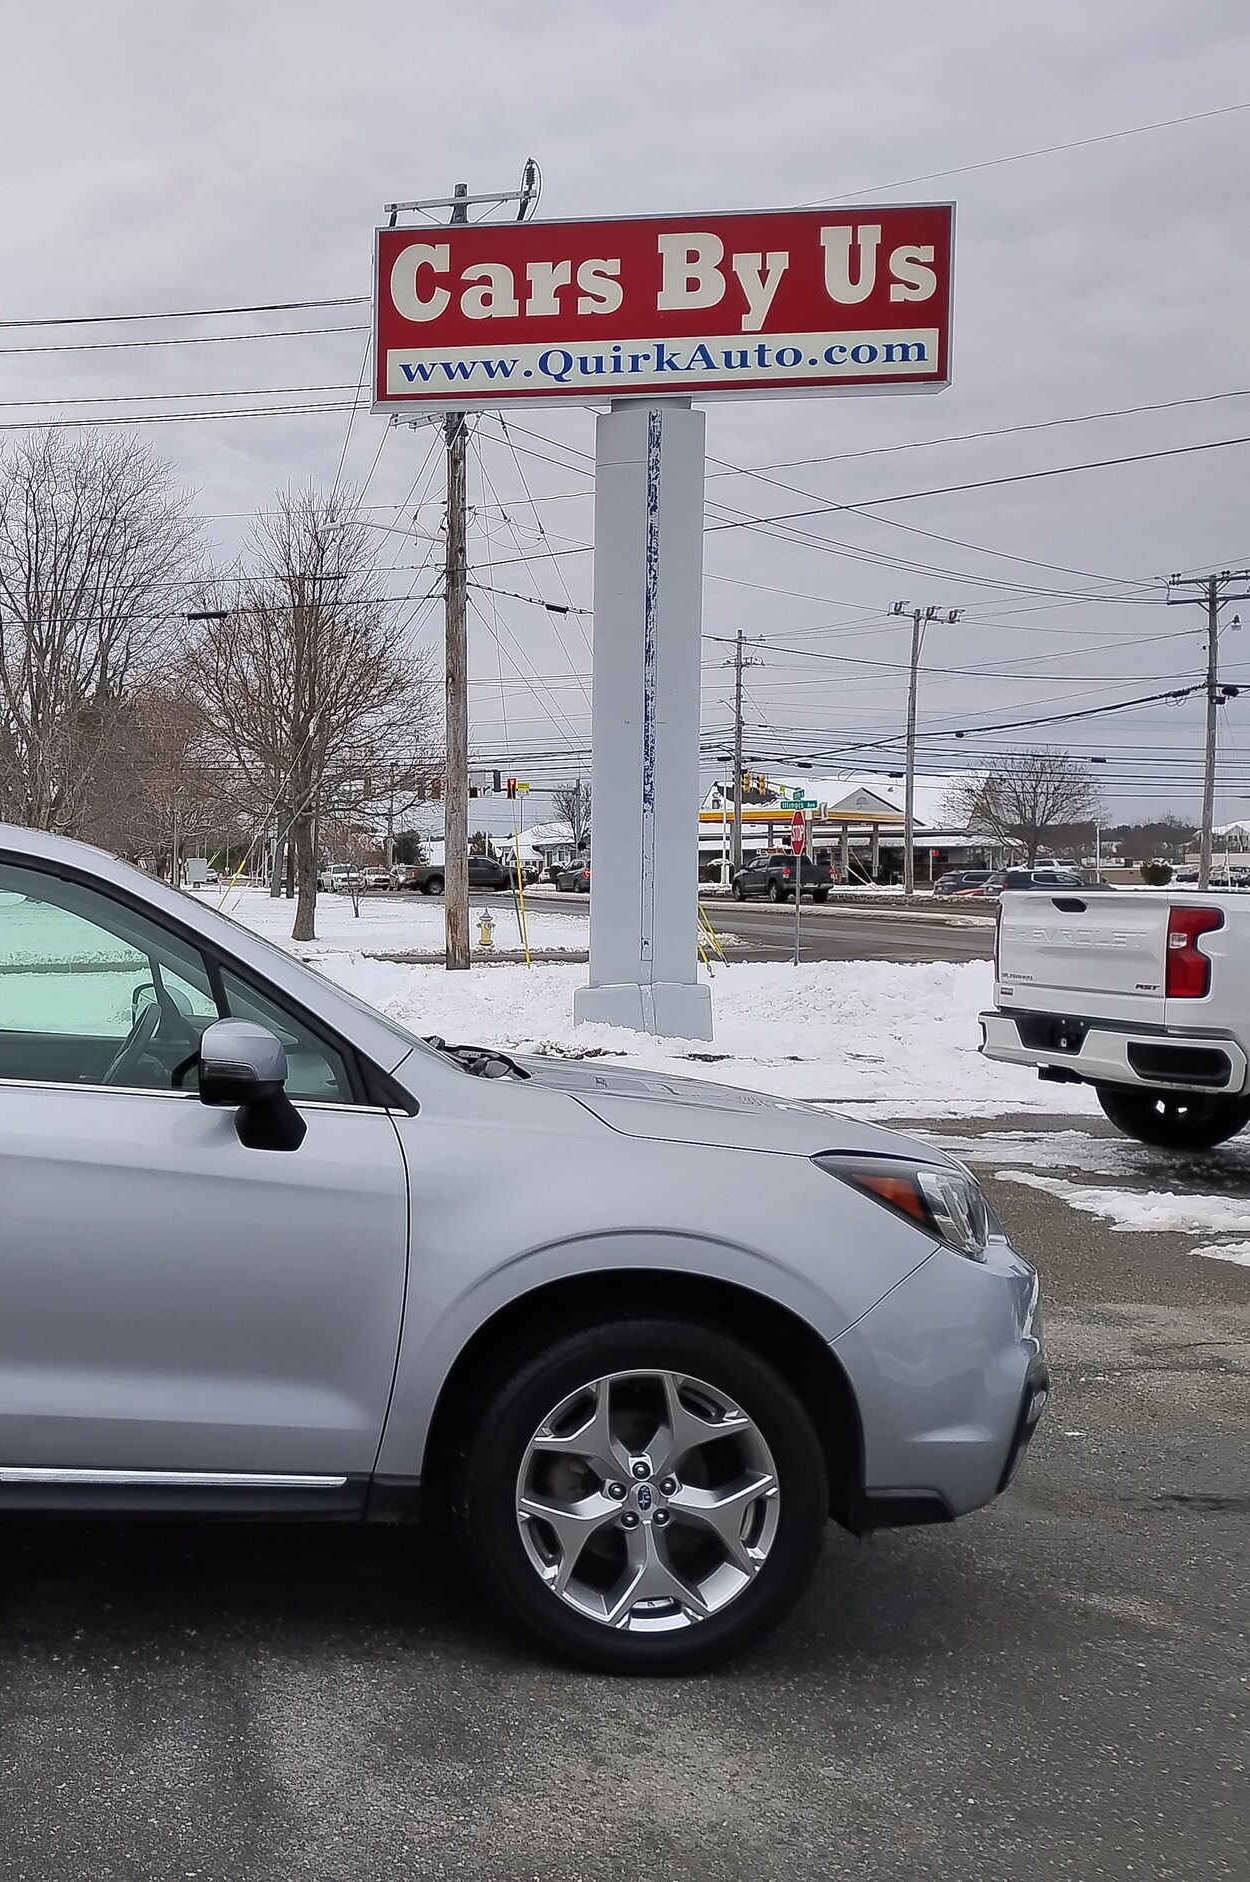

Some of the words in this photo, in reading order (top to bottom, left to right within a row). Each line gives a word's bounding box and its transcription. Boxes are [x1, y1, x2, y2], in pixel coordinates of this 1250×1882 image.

[390, 243, 623, 323] Cars
[656, 231, 789, 332] By
[820, 224, 938, 304] Us
[398, 340, 930, 384] www.QuirkAuto.com
[792, 824, 804, 841] STOP
[1135, 983, 1161, 991] RST
